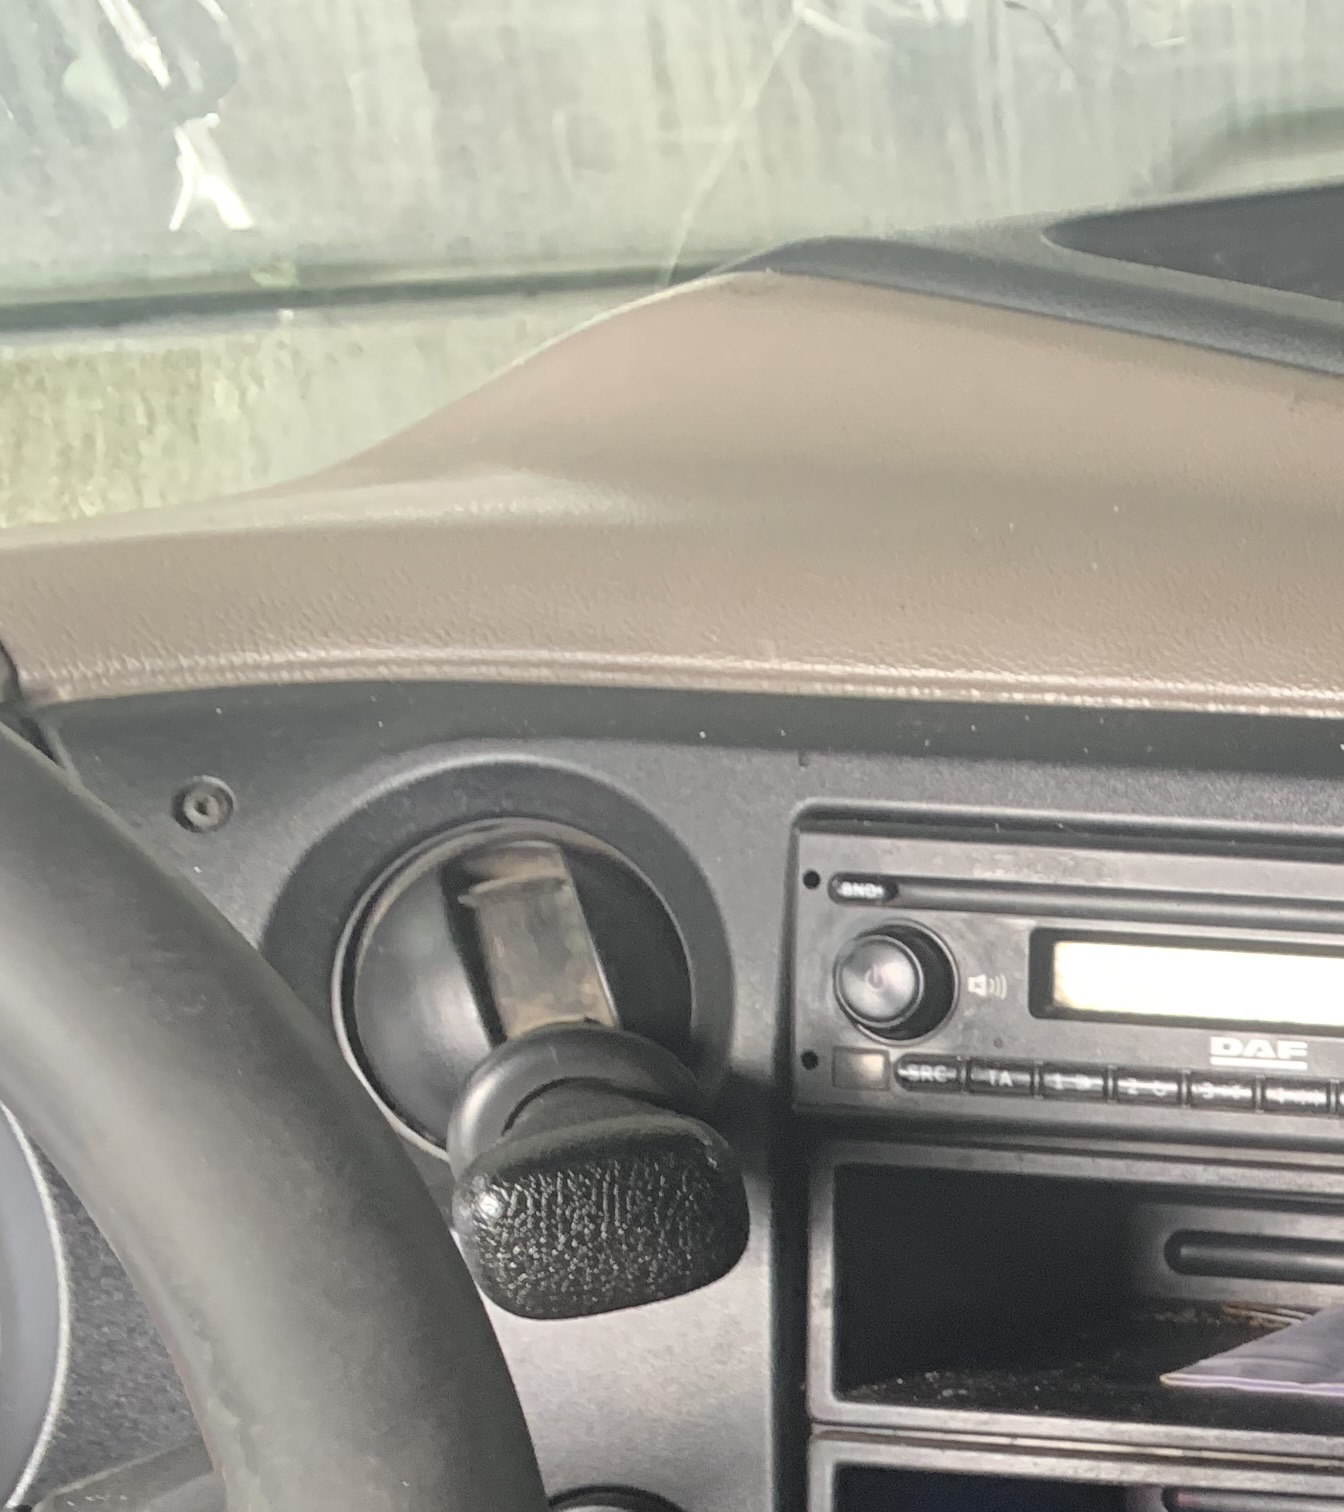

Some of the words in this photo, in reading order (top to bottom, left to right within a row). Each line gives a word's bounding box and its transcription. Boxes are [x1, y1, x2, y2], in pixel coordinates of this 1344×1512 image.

[1209, 1036, 1309, 1061] DAF
[906, 1064, 948, 1083] SRC
[988, 1069, 1014, 1087] TA
